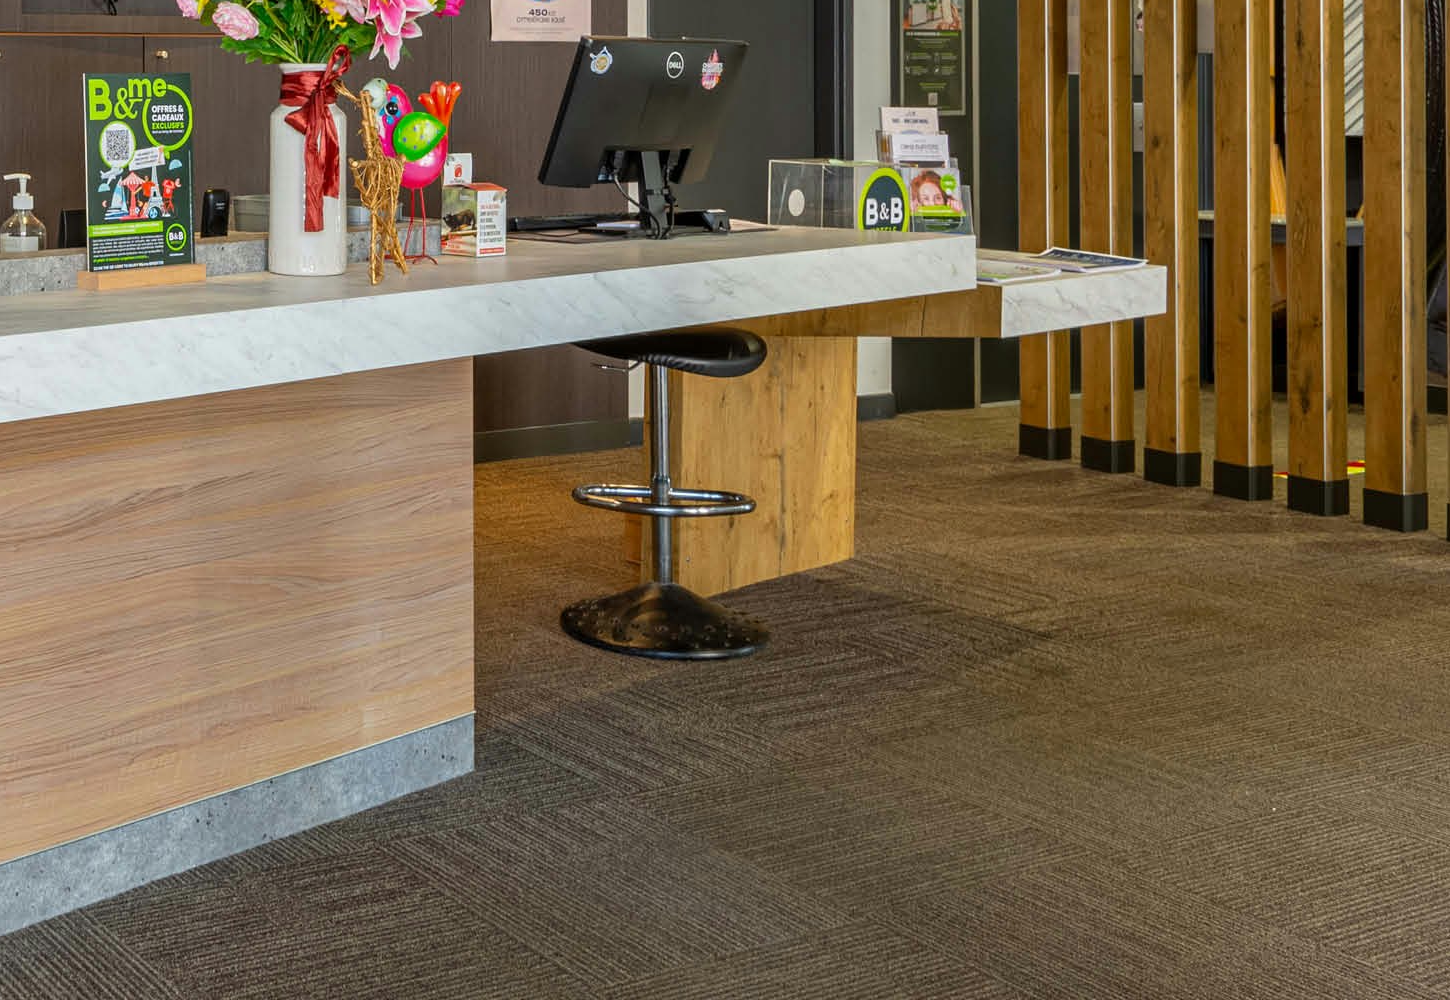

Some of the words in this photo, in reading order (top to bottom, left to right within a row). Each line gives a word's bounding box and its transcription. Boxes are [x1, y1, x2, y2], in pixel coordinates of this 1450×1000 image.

[528, 8, 548, 17] 450
[669, 61, 682, 70] DELL
[151, 105, 177, 113] OFFRES
[177, 104, 184, 113] &
[151, 113, 184, 122] CADEAUX
[151, 121, 185, 130] EXCLUSIFS
[865, 197, 903, 226] B&B
[168, 231, 184, 241] B&B
